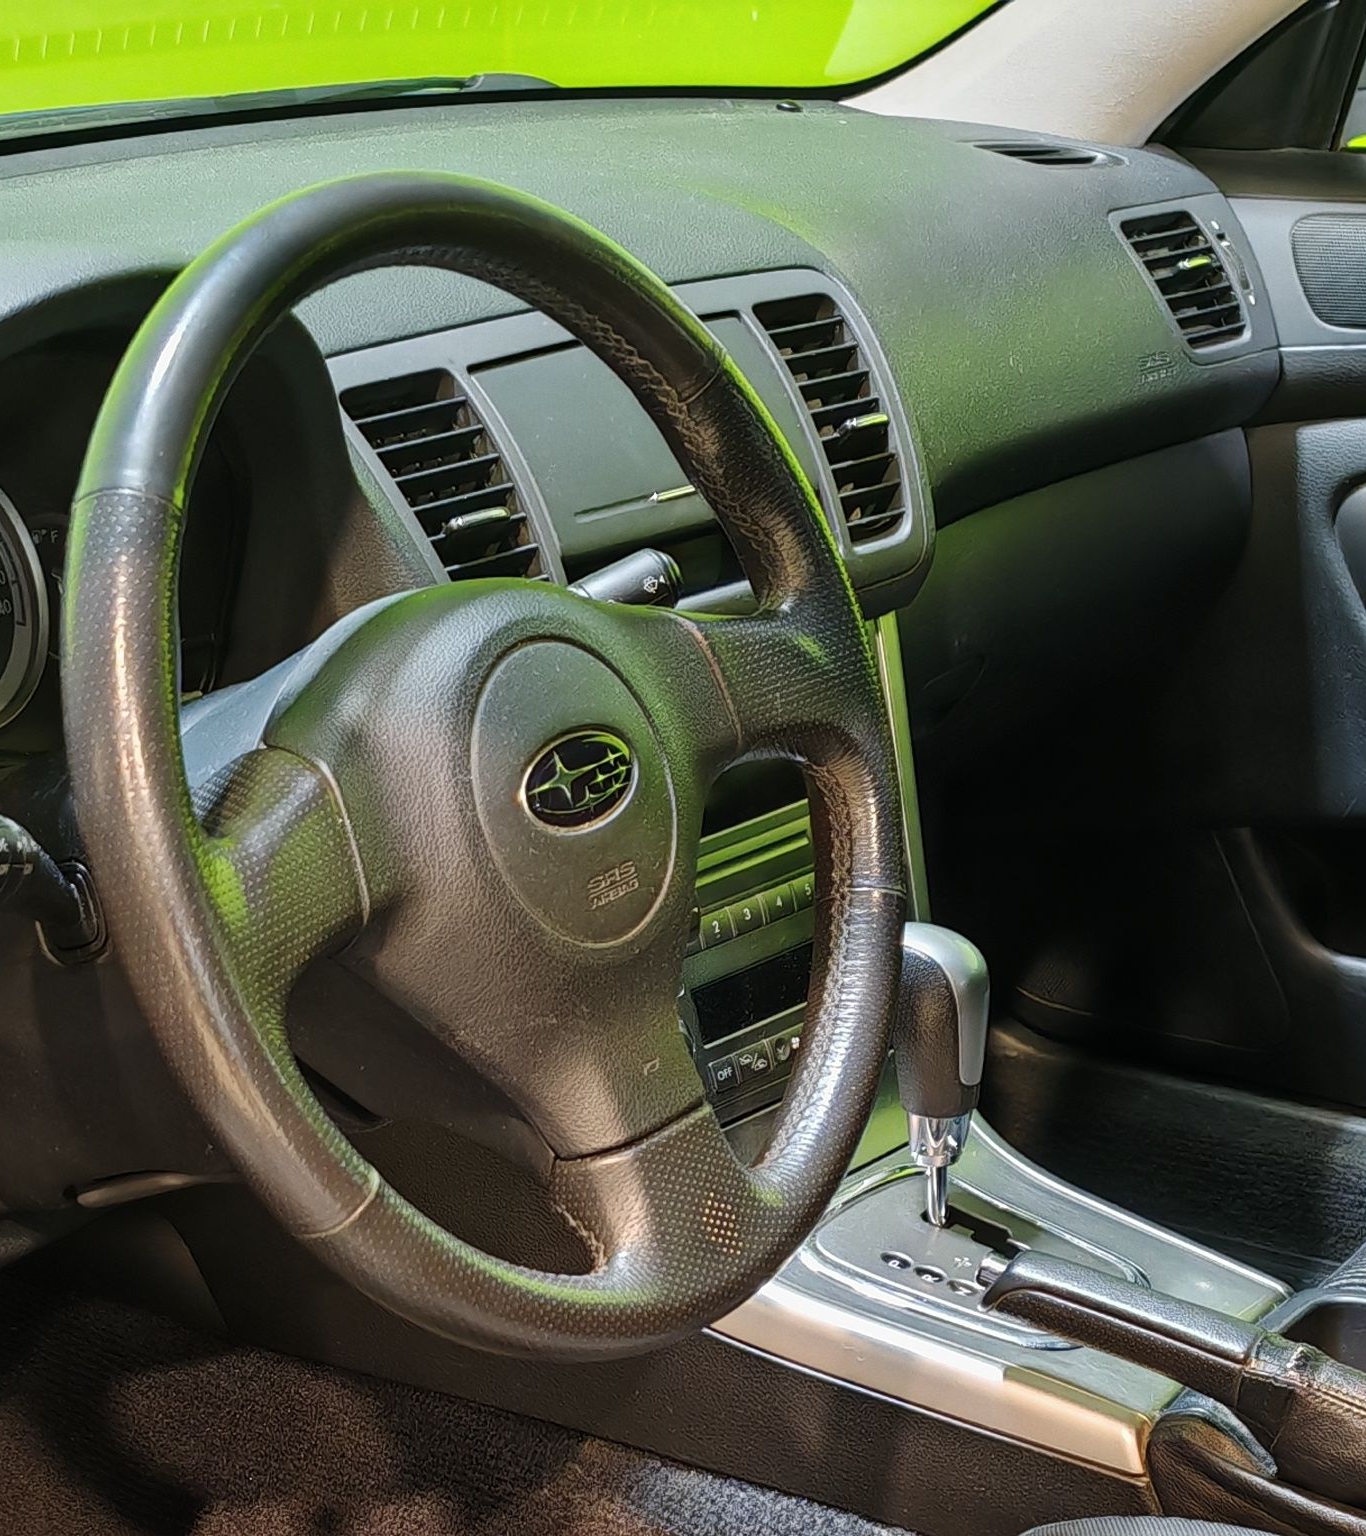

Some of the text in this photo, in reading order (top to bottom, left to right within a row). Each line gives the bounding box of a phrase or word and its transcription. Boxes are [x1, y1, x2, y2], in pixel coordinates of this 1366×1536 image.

[804, 883, 813, 896] 5
[775, 895, 784, 908] 4
[742, 907, 752, 921] 3
[711, 920, 721, 934] 2
[716, 1066, 734, 1081] OFF
[888, 1260, 901, 1269] P
[921, 1274, 940, 1283] R
[955, 1286, 972, 1296] N
